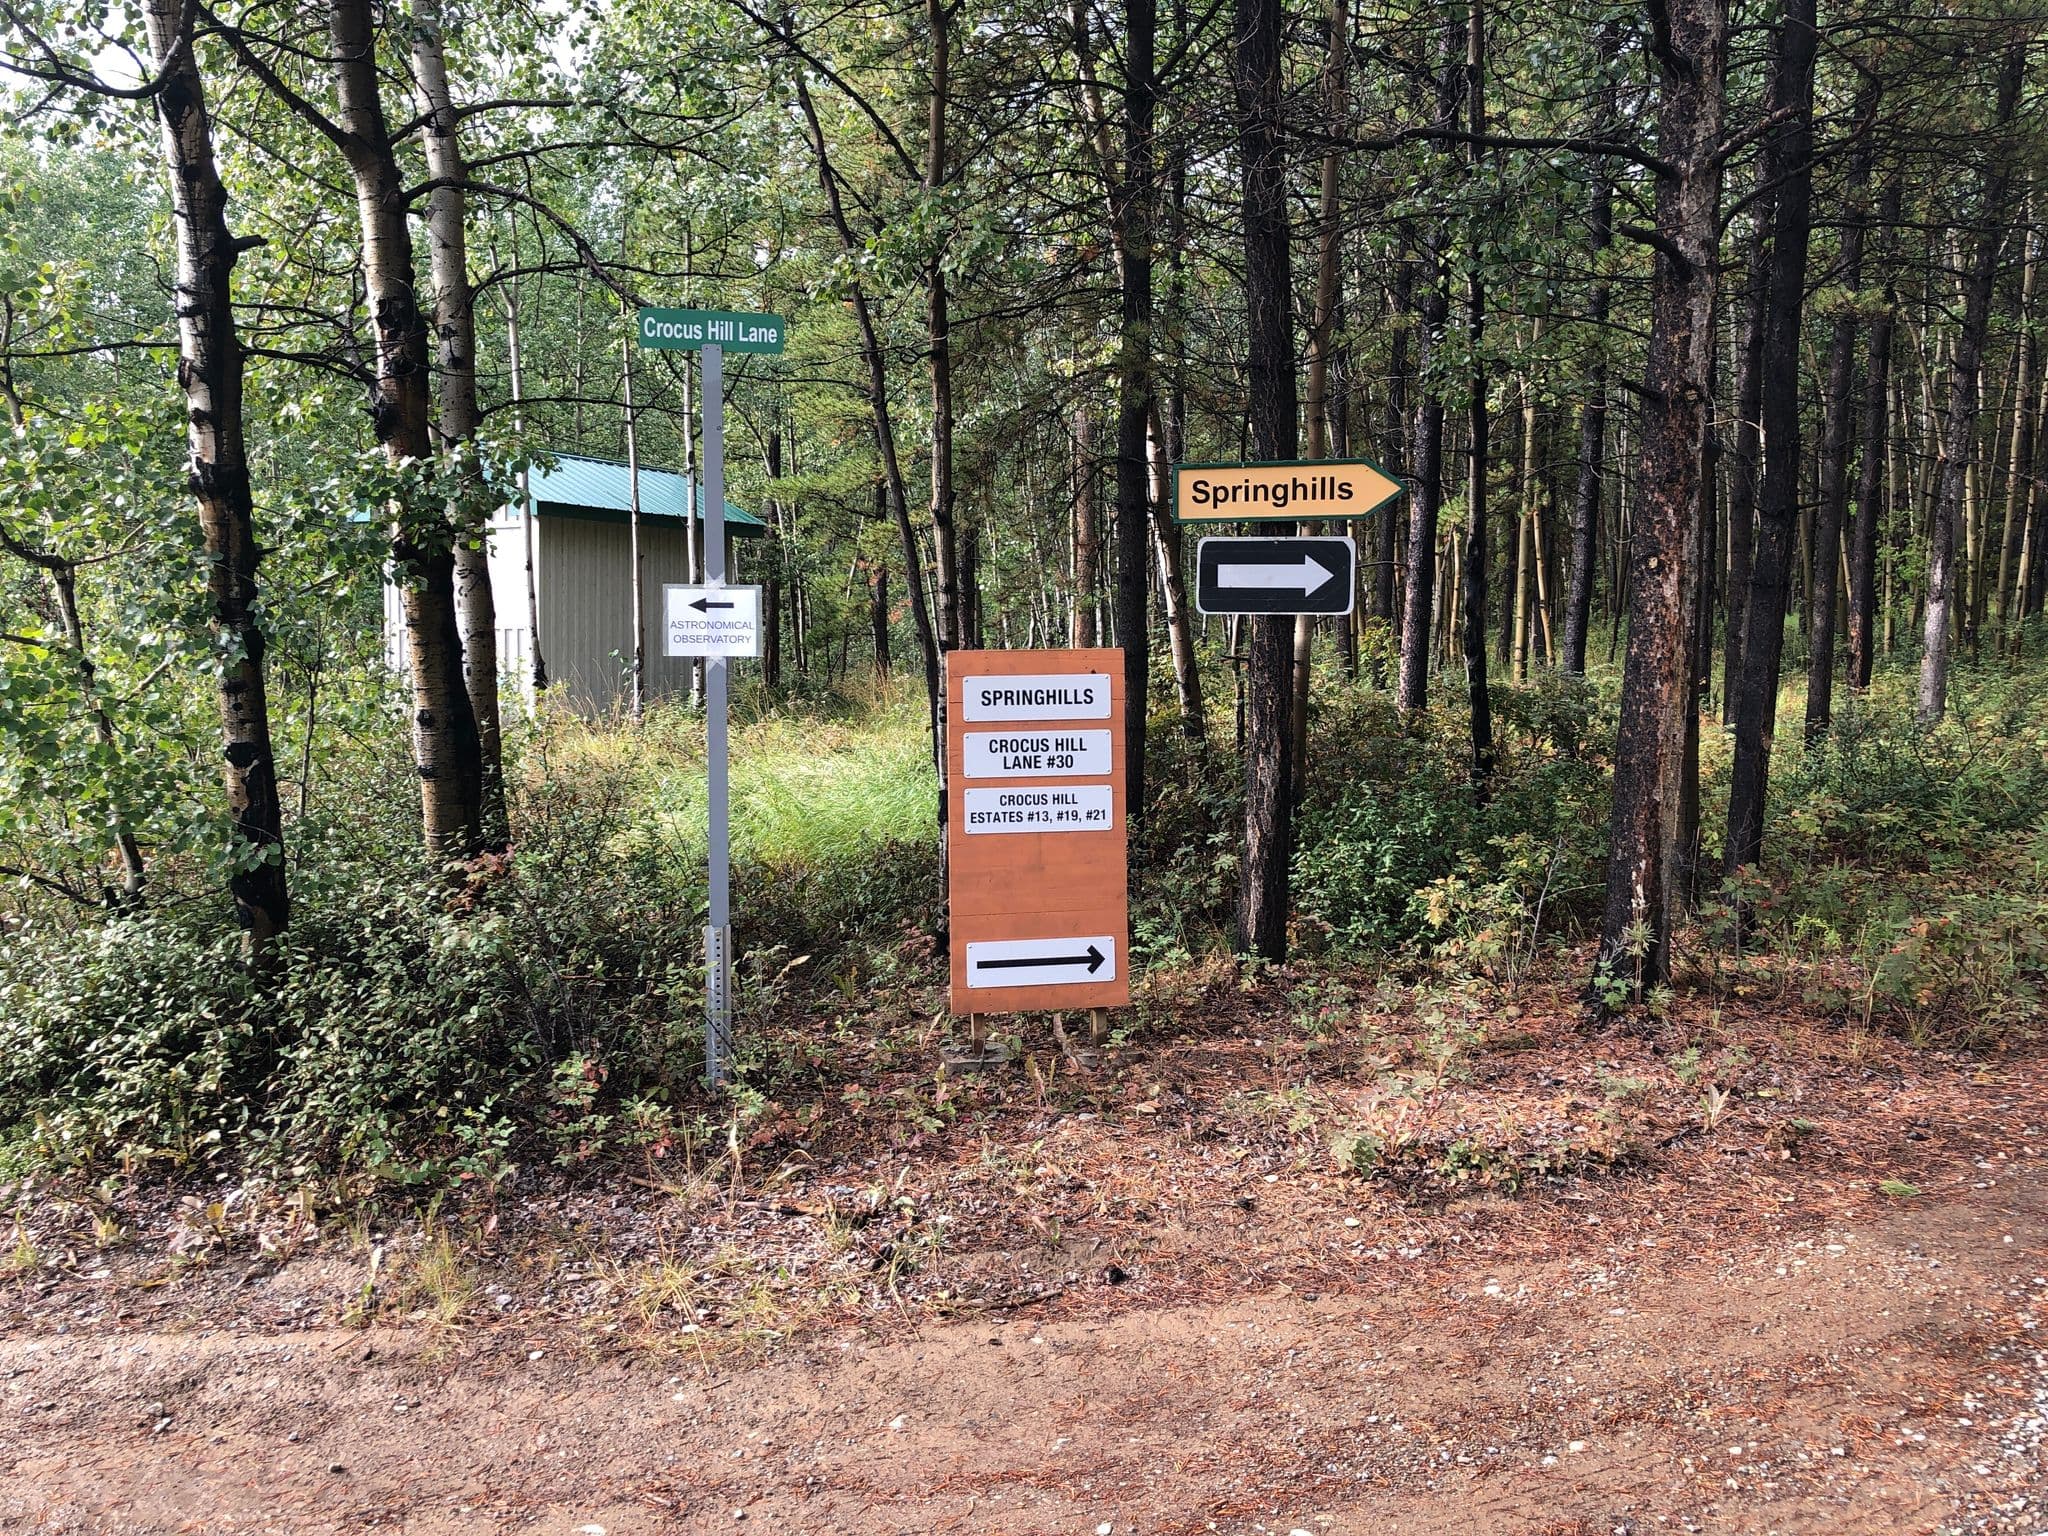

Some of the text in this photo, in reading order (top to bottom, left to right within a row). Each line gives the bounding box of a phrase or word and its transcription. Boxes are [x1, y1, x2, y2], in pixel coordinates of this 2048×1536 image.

[644, 316, 778, 344] Crocus Hill Lane
[1191, 476, 1354, 509] Springhills
[670, 620, 755, 630] ASTRONOMICAL
[673, 634, 752, 644] OBSERVATORY
[981, 688, 1094, 707] SPRINGHILLS
[988, 737, 1088, 754] CROCUS HILL
[1003, 754, 1074, 770] LANE #30
[999, 793, 1079, 807] CROCUS HILL
[970, 809, 1106, 824] ESTATES #13, #19, #21
